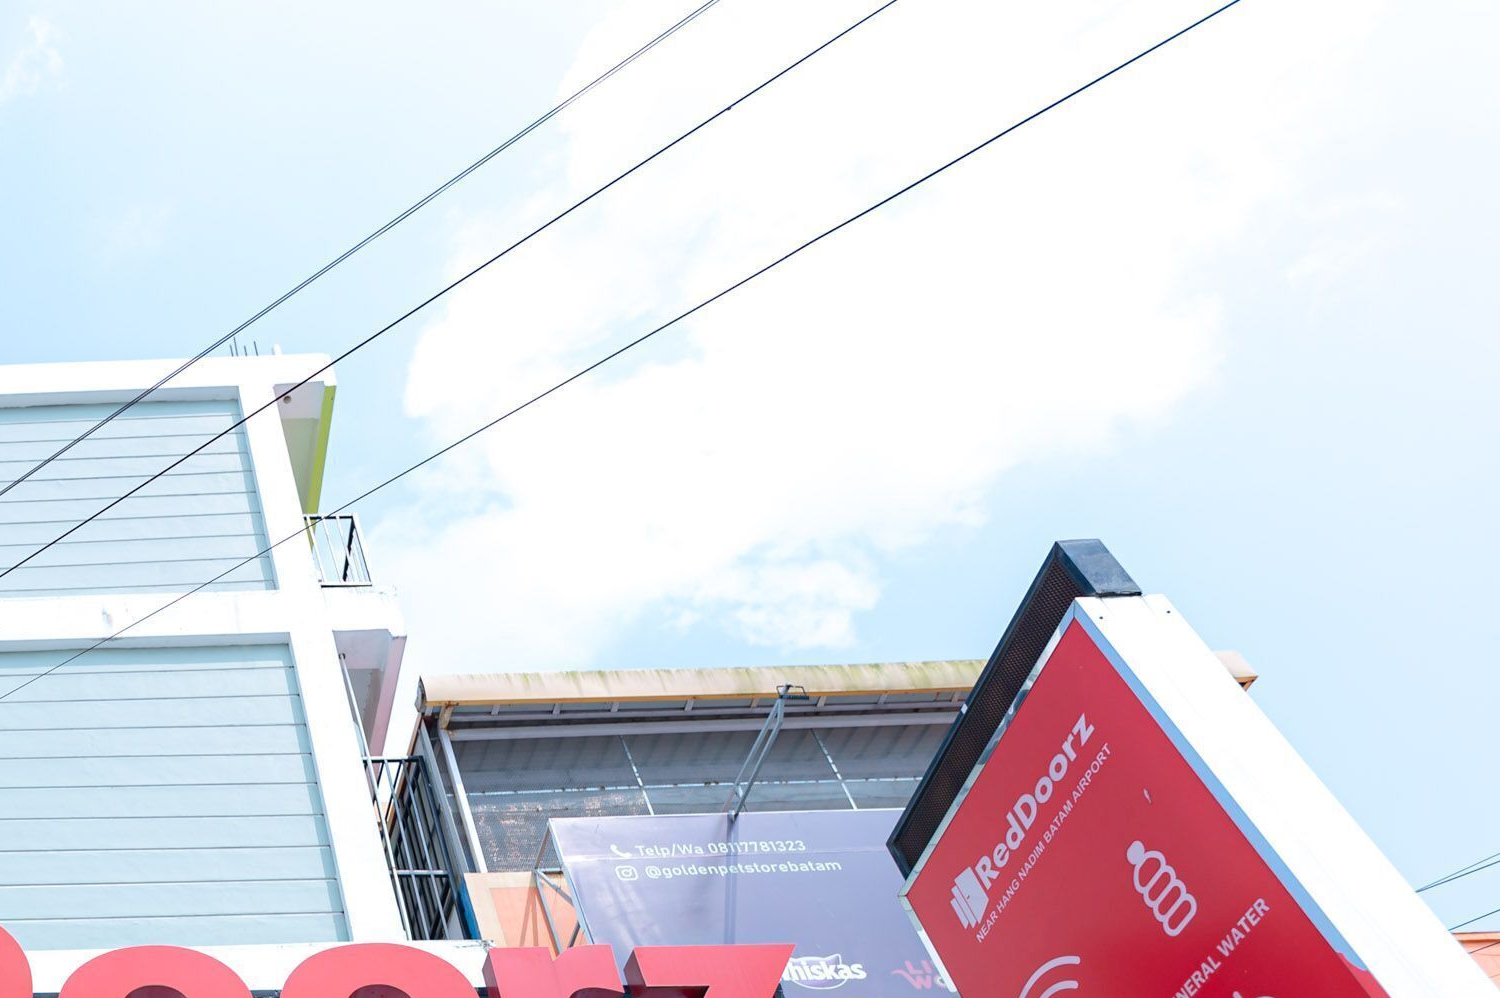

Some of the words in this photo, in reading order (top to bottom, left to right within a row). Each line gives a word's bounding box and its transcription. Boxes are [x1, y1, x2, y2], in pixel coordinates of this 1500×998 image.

[975, 713, 1095, 889] RedDoorz
[635, 844, 703, 858] Telp/Wa
[707, 840, 806, 854] 08117781323
[976, 912, 998, 943] NEAR
[996, 879, 1020, 913] HANG
[1018, 841, 1045, 881] NADIM
[1043, 800, 1073, 844] BATAM
[1072, 743, 1111, 803] AIRPORT
[645, 860, 842, 880] @goldenpetstorebatam
[1216, 898, 1270, 957] WATER
[781, 960, 868, 982] hiskas
